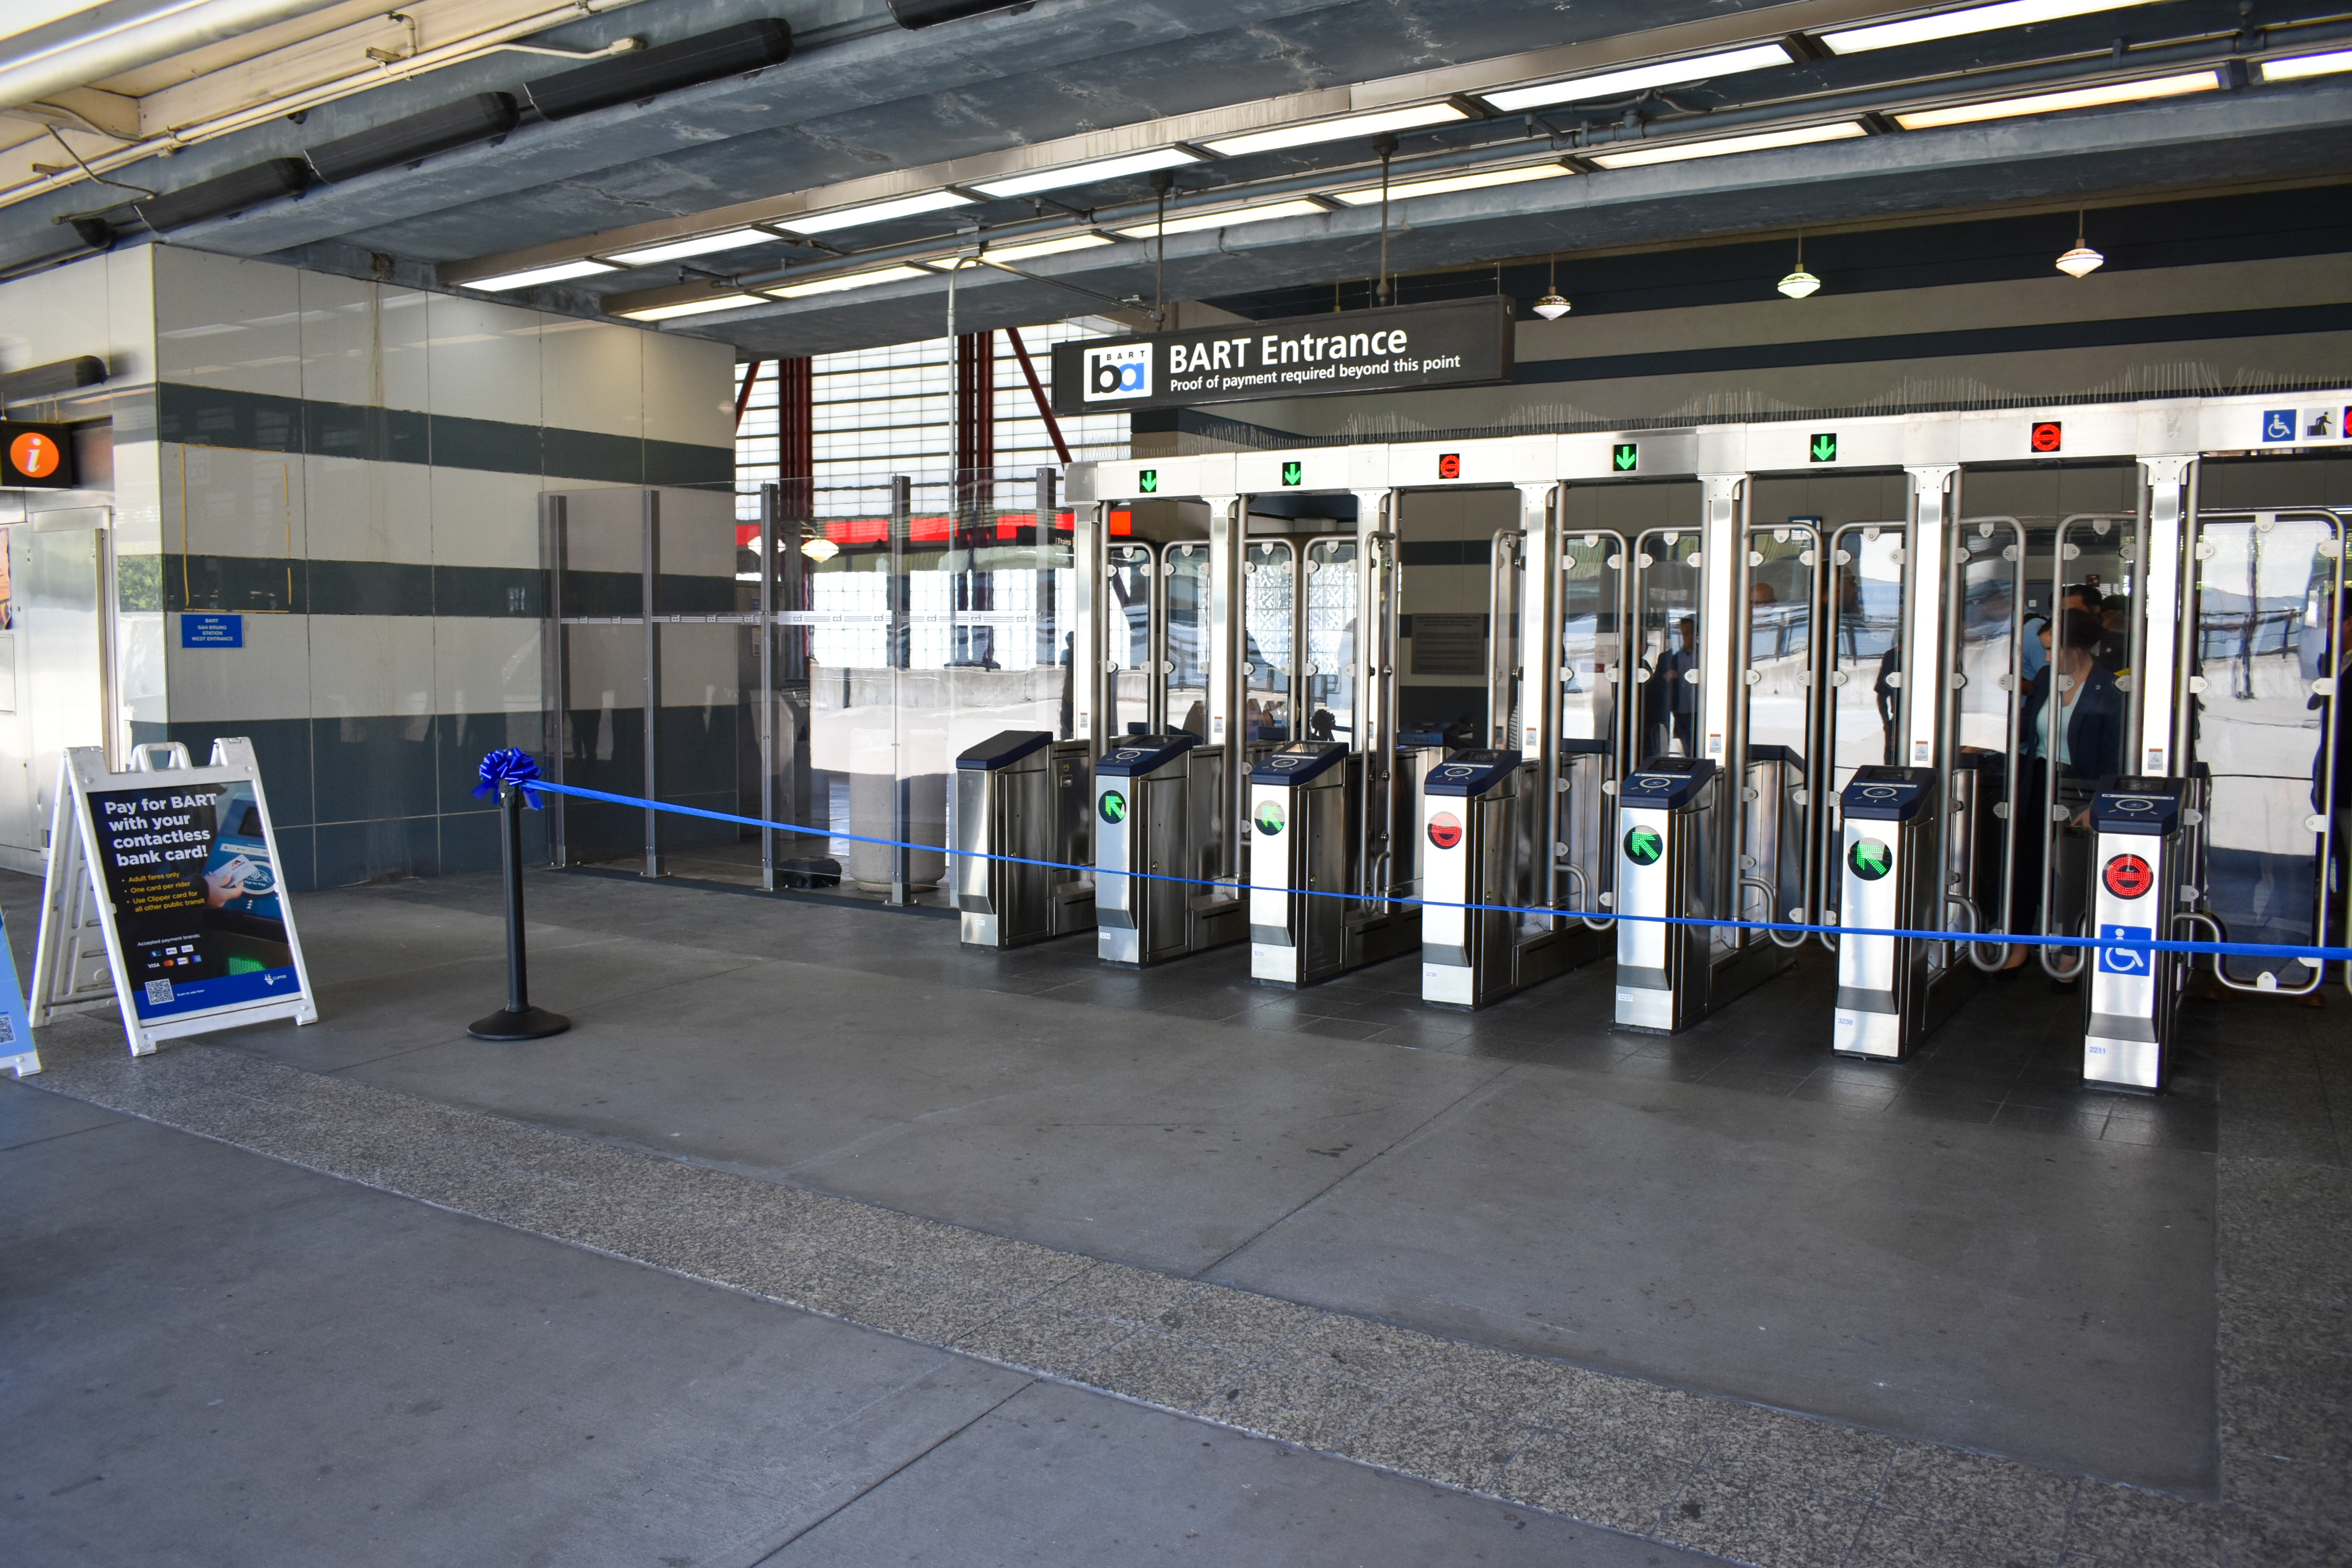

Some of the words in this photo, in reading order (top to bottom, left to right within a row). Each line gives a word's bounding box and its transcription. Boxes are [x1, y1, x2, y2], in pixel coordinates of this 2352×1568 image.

[1107, 350, 1145, 360] BART
[1170, 338, 1251, 373] BART
[1262, 329, 1407, 366] Entrance
[1170, 376, 1202, 392] Proof
[1206, 375, 1219, 388] of
[1223, 372, 1277, 390] payment
[1281, 365, 1335, 384] required
[1339, 359, 1389, 379] beyond
[1393, 357, 1418, 373] this
[1423, 355, 1460, 373] point
[105, 802, 136, 815] Pay
[141, 798, 166, 811] for
[171, 793, 217, 808] BART
[109, 817, 148, 831] with
[152, 815, 191, 830] your
[113, 830, 211, 848] contactless
[116, 850, 161, 866] bank
[165, 845, 208, 861] card!
[163, 901, 183, 909] public
